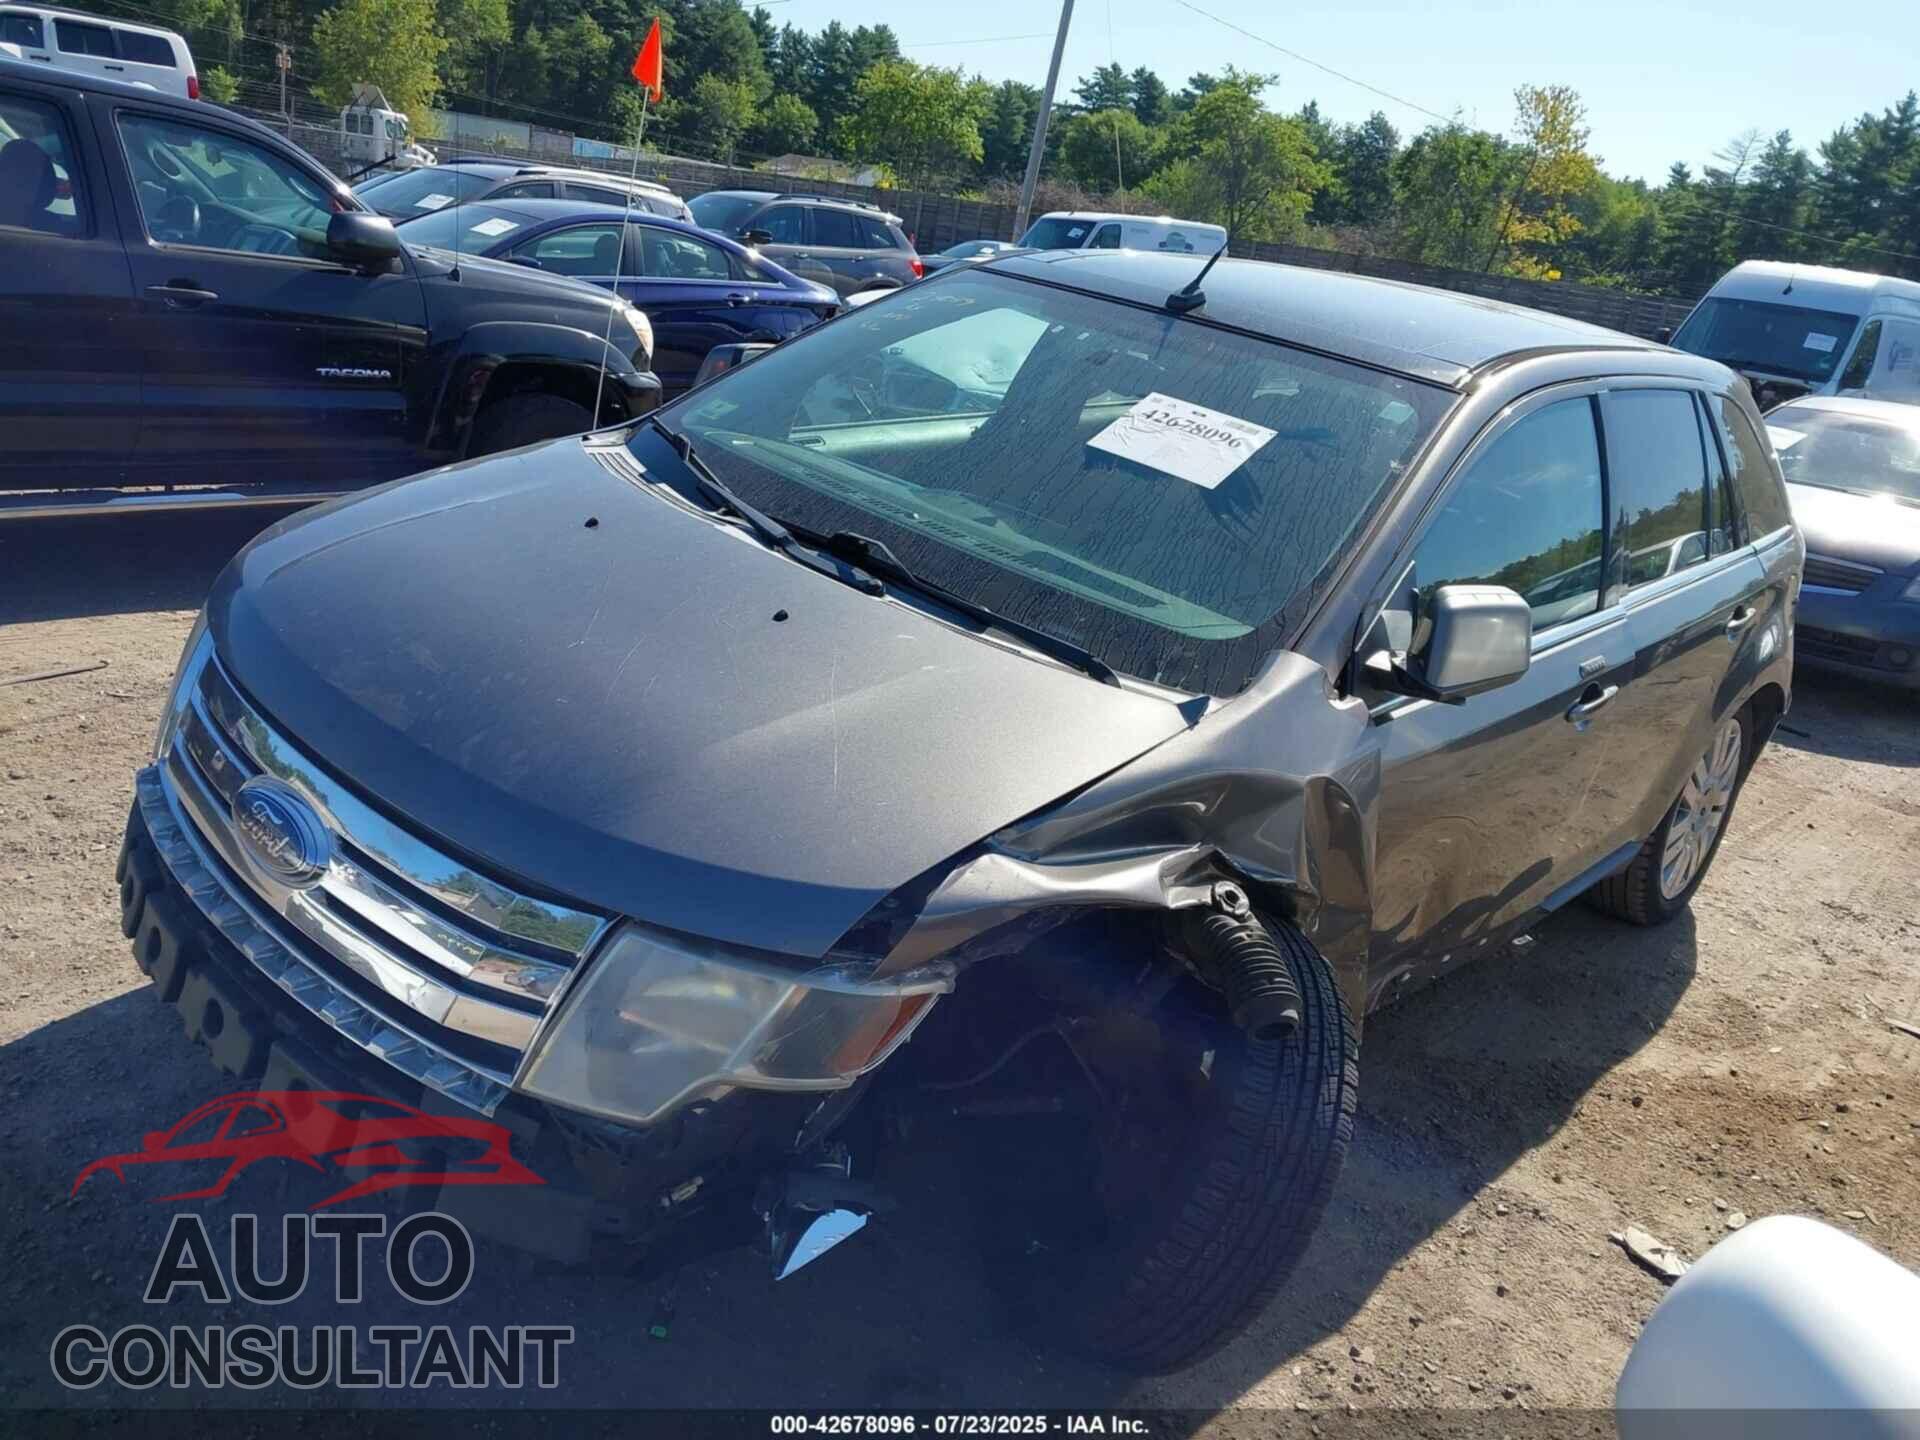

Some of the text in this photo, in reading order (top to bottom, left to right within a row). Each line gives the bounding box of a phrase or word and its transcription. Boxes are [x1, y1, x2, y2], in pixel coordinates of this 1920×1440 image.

[315, 367, 392, 379] TACOMA
[1140, 409, 1242, 449] 42678096
[240, 801, 290, 857] Ford
